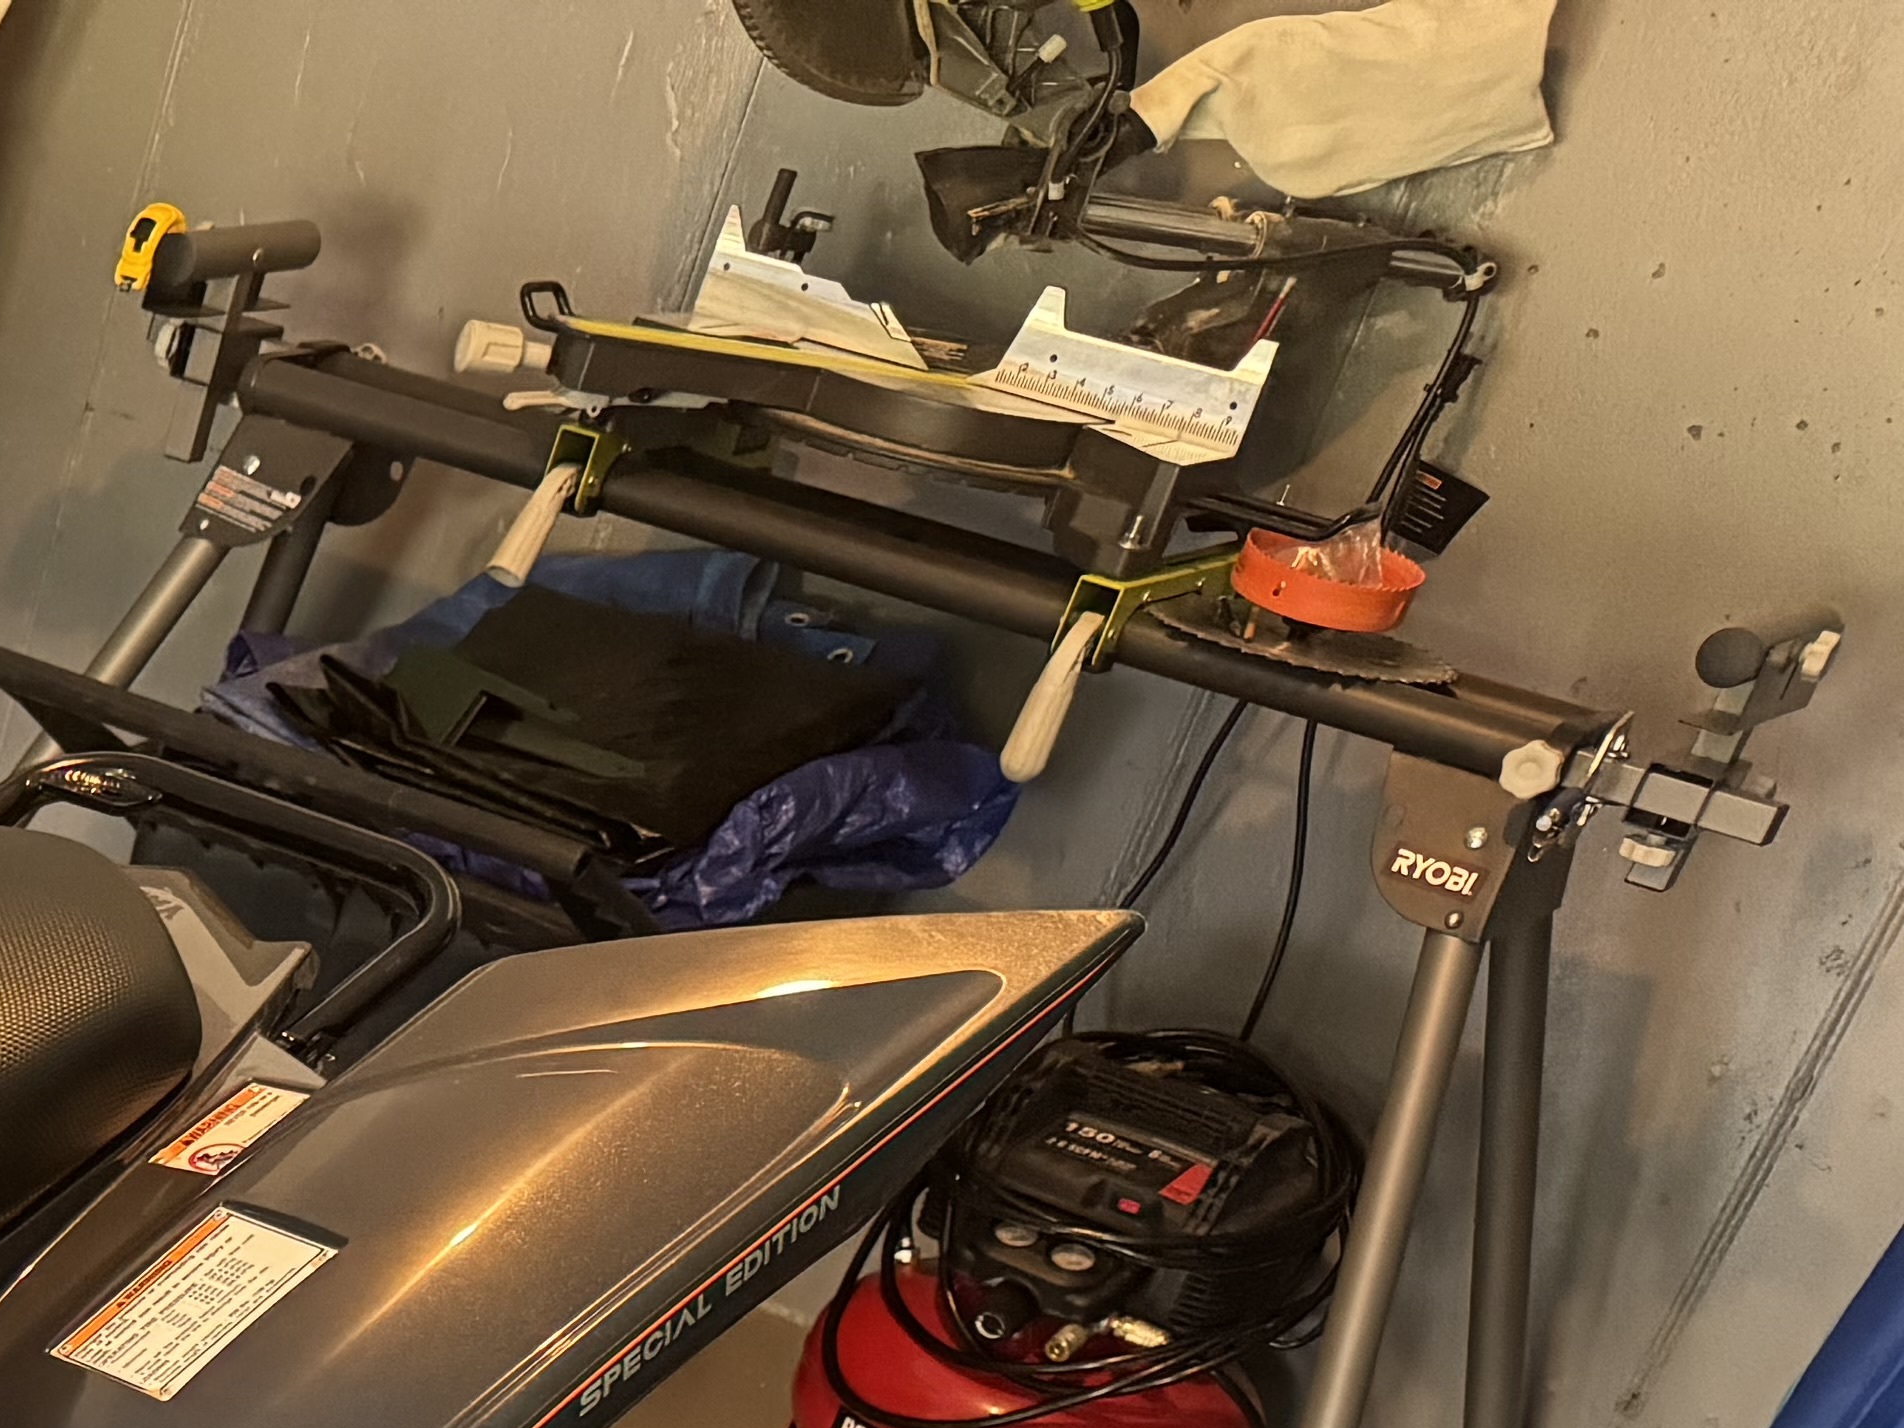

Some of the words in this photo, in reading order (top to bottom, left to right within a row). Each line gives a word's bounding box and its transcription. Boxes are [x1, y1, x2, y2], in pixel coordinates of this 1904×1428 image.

[1391, 848, 1478, 896] RYOBI
[579, 1294, 713, 1417] SPECIAL
[725, 1184, 841, 1297] EDITION
